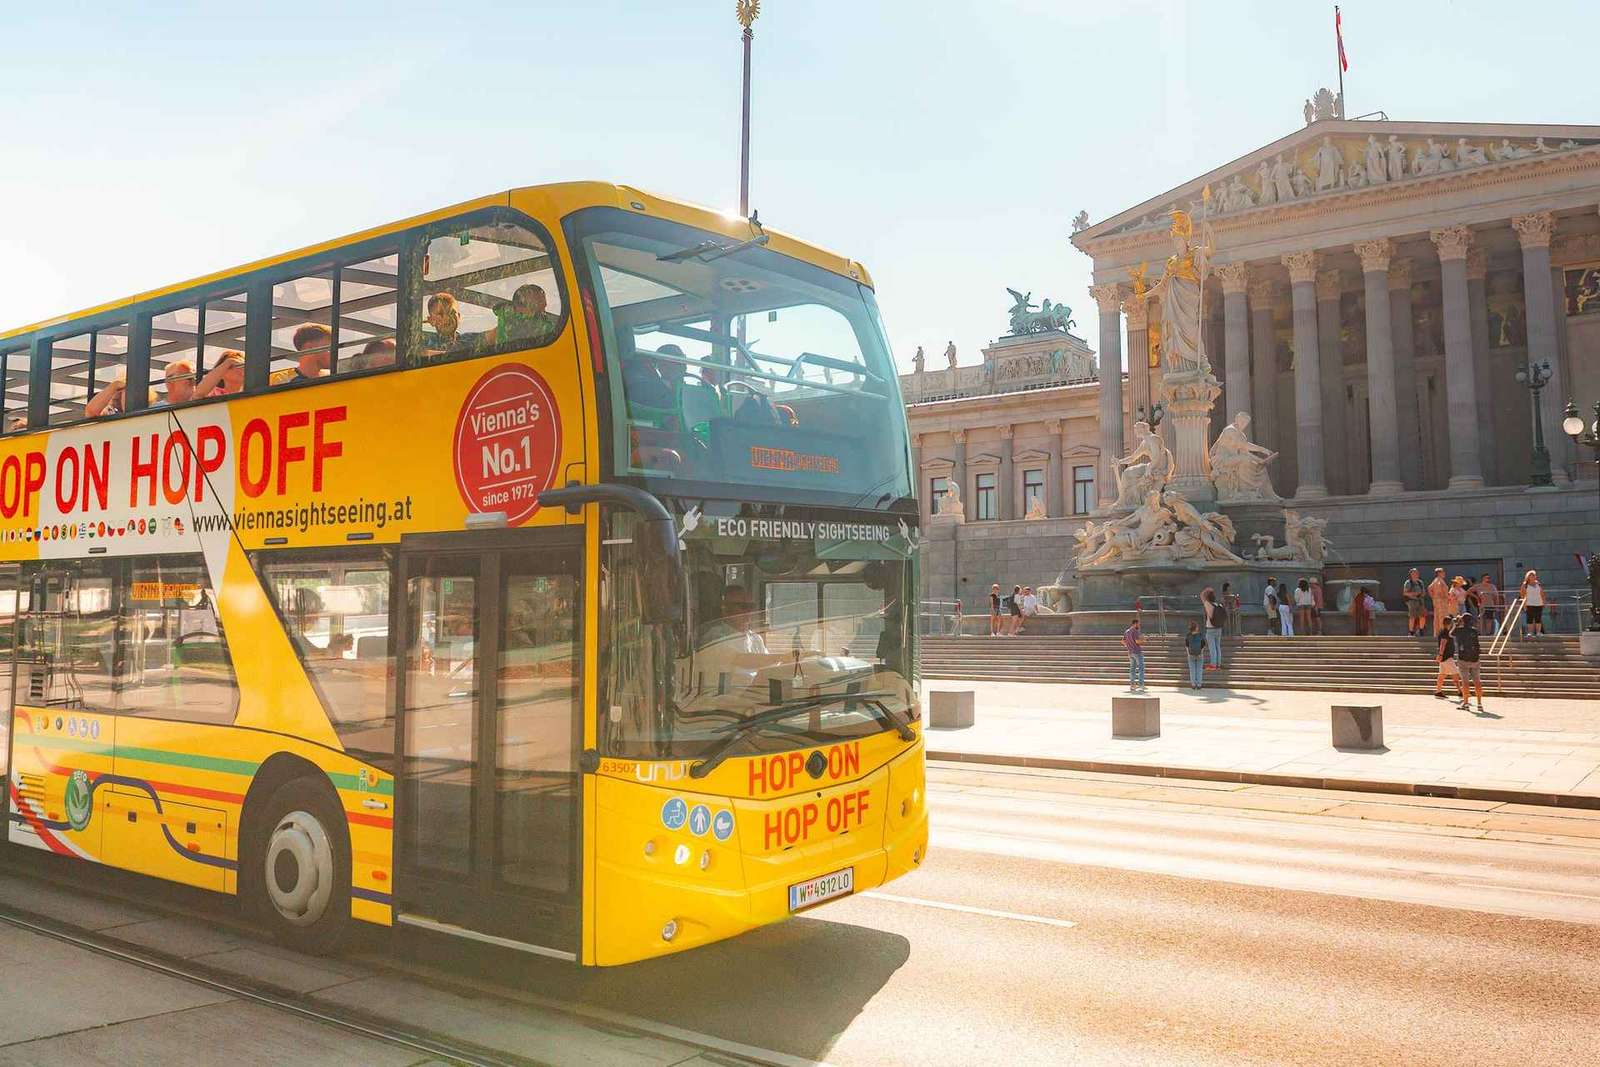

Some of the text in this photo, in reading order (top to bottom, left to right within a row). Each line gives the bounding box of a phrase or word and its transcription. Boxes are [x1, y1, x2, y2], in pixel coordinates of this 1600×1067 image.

[471, 400, 539, 435] Vienna's
[54, 440, 111, 515] ON
[129, 424, 227, 508] HOP
[239, 406, 348, 499] OFF
[482, 435, 531, 478] No.1
[192, 496, 412, 533] www.viennasightseeing.at
[482, 483, 534, 506] since 1972
[718, 518, 890, 541] ECO FRIENDLY SIGHTSEEING
[749, 741, 860, 796] HOP ON
[764, 789, 870, 850] HOP OFF
